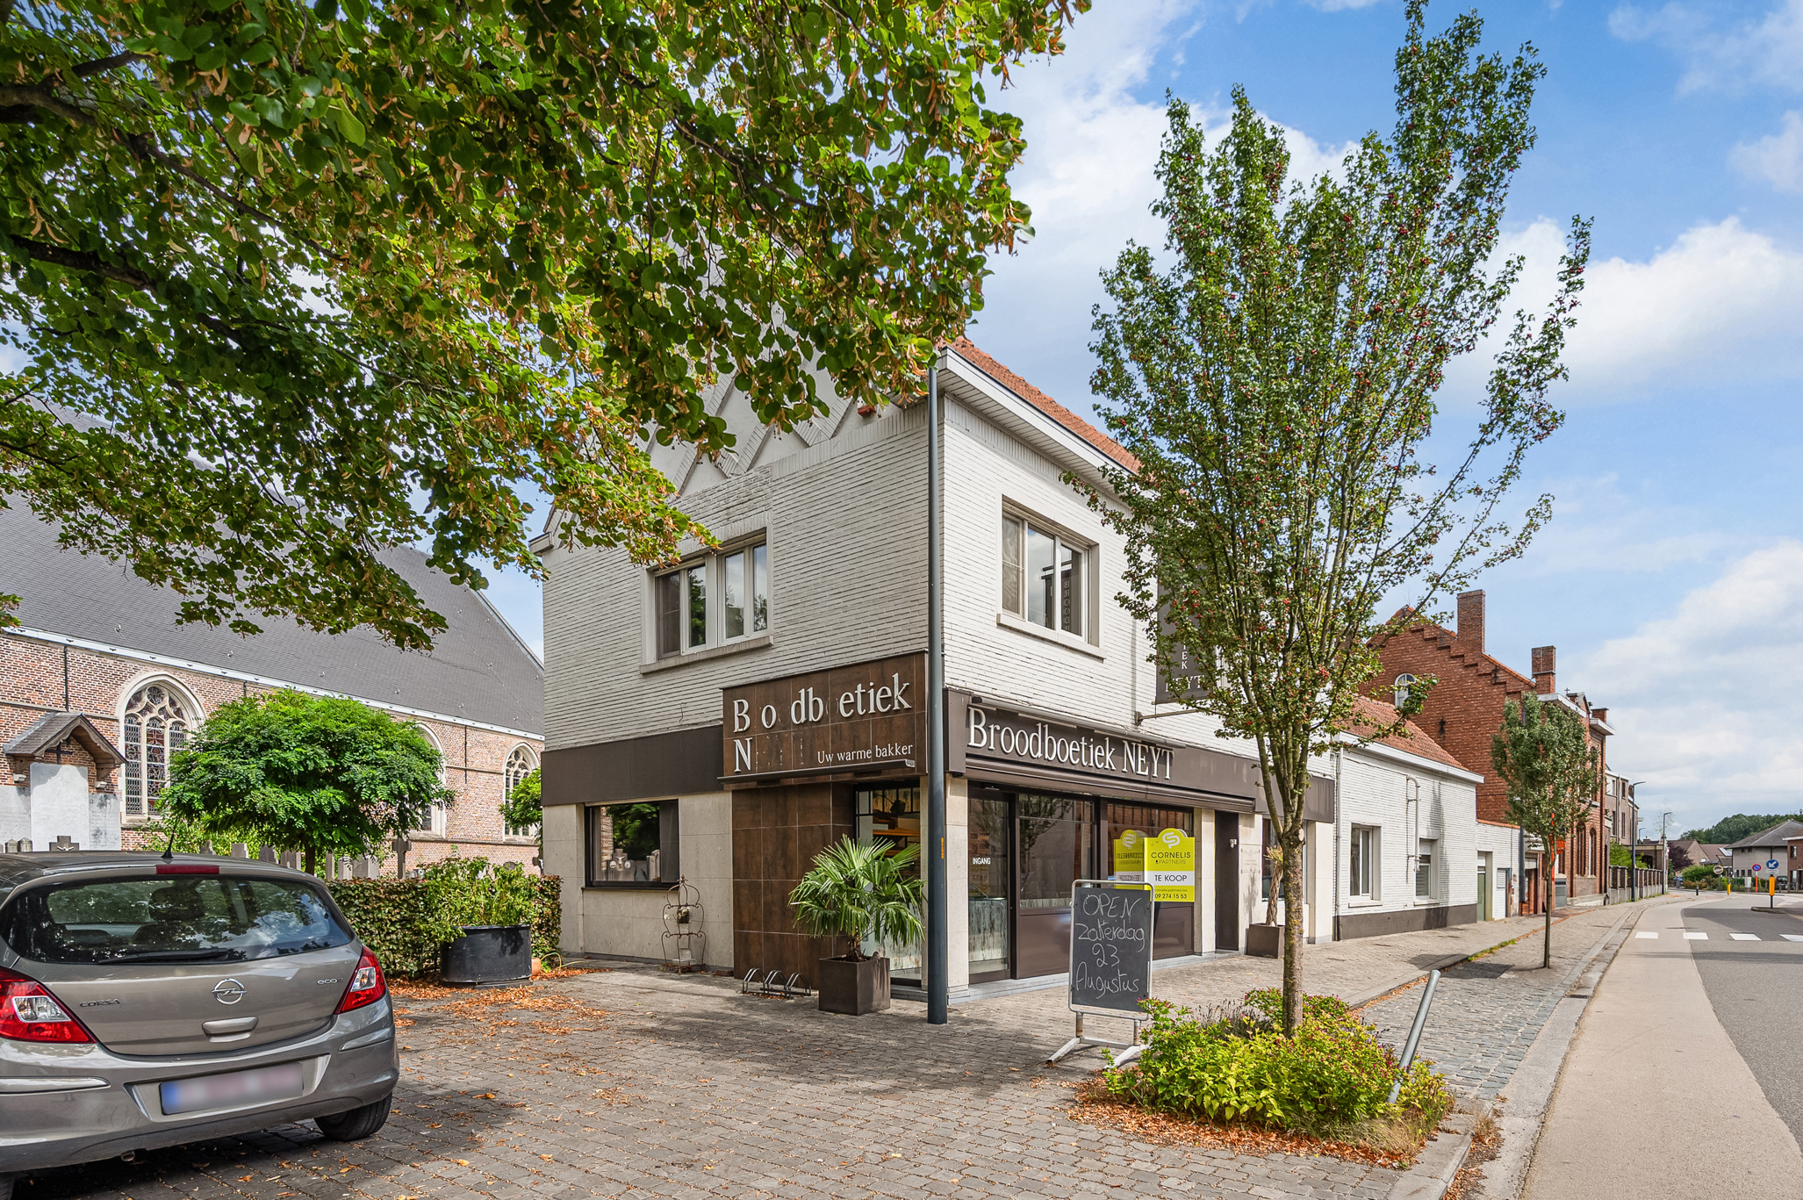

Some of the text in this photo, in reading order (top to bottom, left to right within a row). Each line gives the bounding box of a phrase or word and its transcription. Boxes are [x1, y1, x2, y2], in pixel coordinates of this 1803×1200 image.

[817, 742, 913, 764] Uw warme bakker
[968, 706, 1175, 780] Broodboetiek NEYT
[972, 857, 991, 865] INGANG
[1150, 851, 1191, 859] CORNELIS
[1154, 874, 1188, 882] TE KOOP
[1083, 893, 1142, 918] OPEN
[1092, 943, 1120, 968] 23
[1075, 961, 1140, 1000] Augustus
